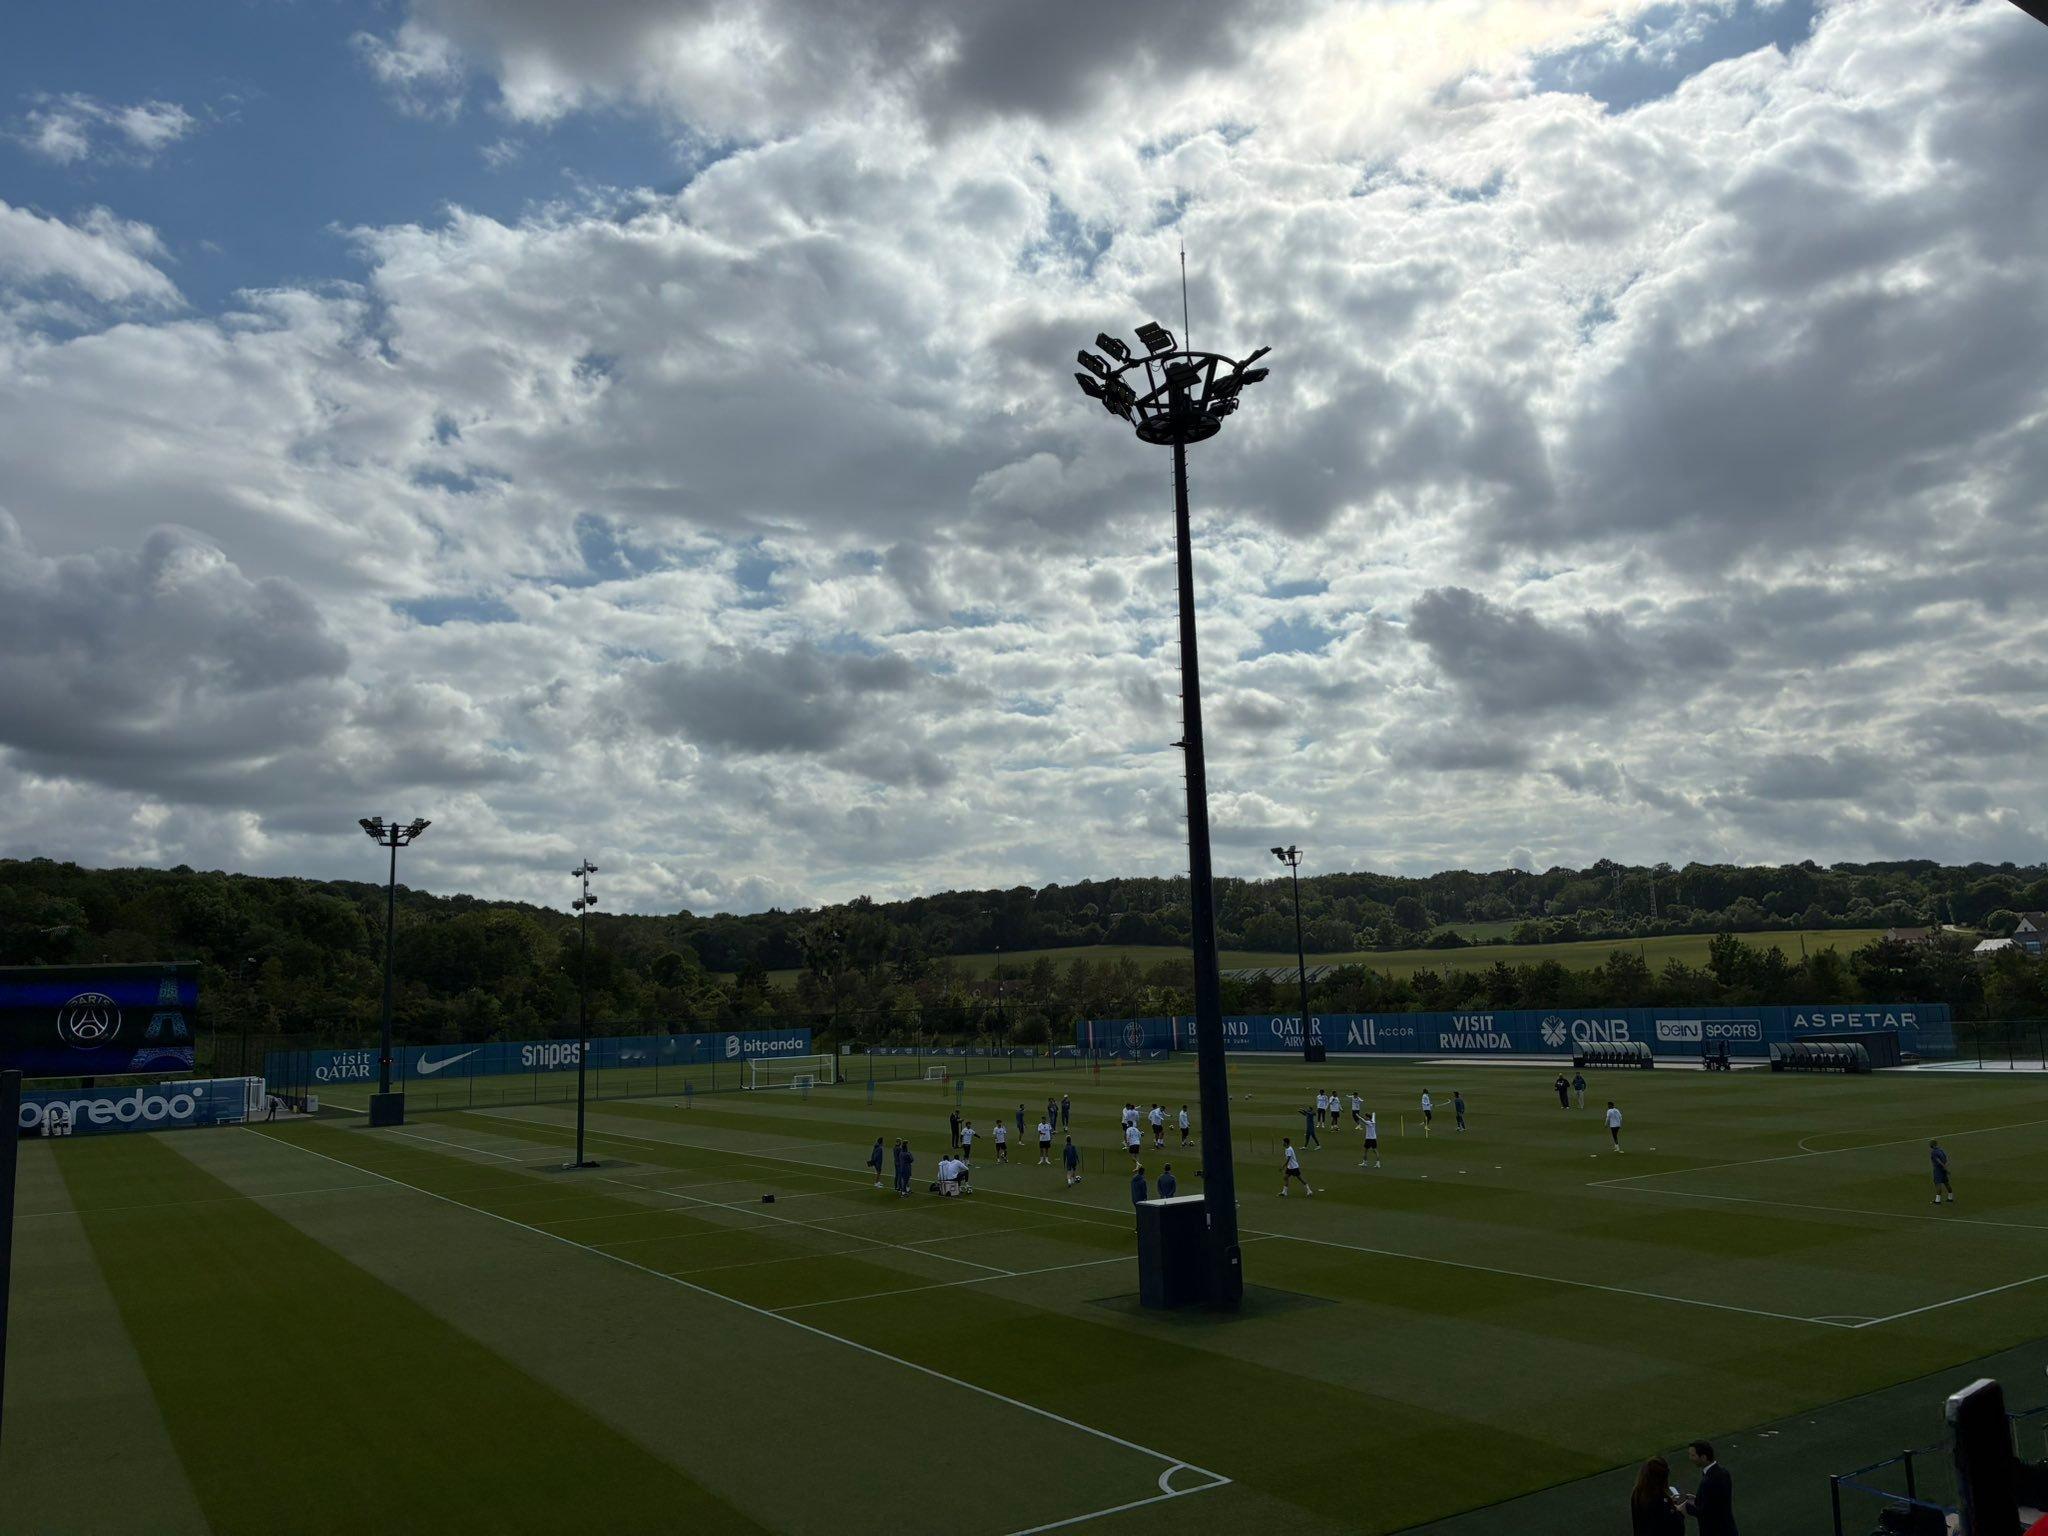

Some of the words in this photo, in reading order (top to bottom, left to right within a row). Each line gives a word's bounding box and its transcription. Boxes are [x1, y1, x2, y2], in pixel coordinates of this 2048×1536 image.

[1188, 1022, 1248, 1036] BND
[1453, 1015, 1493, 1031] VISIT
[1793, 1013, 1919, 1030] ASPETAR
[1378, 1028, 1415, 1036] ACCOR
[1571, 1019, 1630, 1041] QNB
[1706, 1024, 1757, 1038] SPORTS
[743, 1037, 803, 1055] bitpanda
[1440, 1033, 1511, 1048] RWANDA
[332, 1051, 370, 1065] visit
[521, 1042, 580, 1069] snipes
[315, 1064, 370, 1081] QATAR
